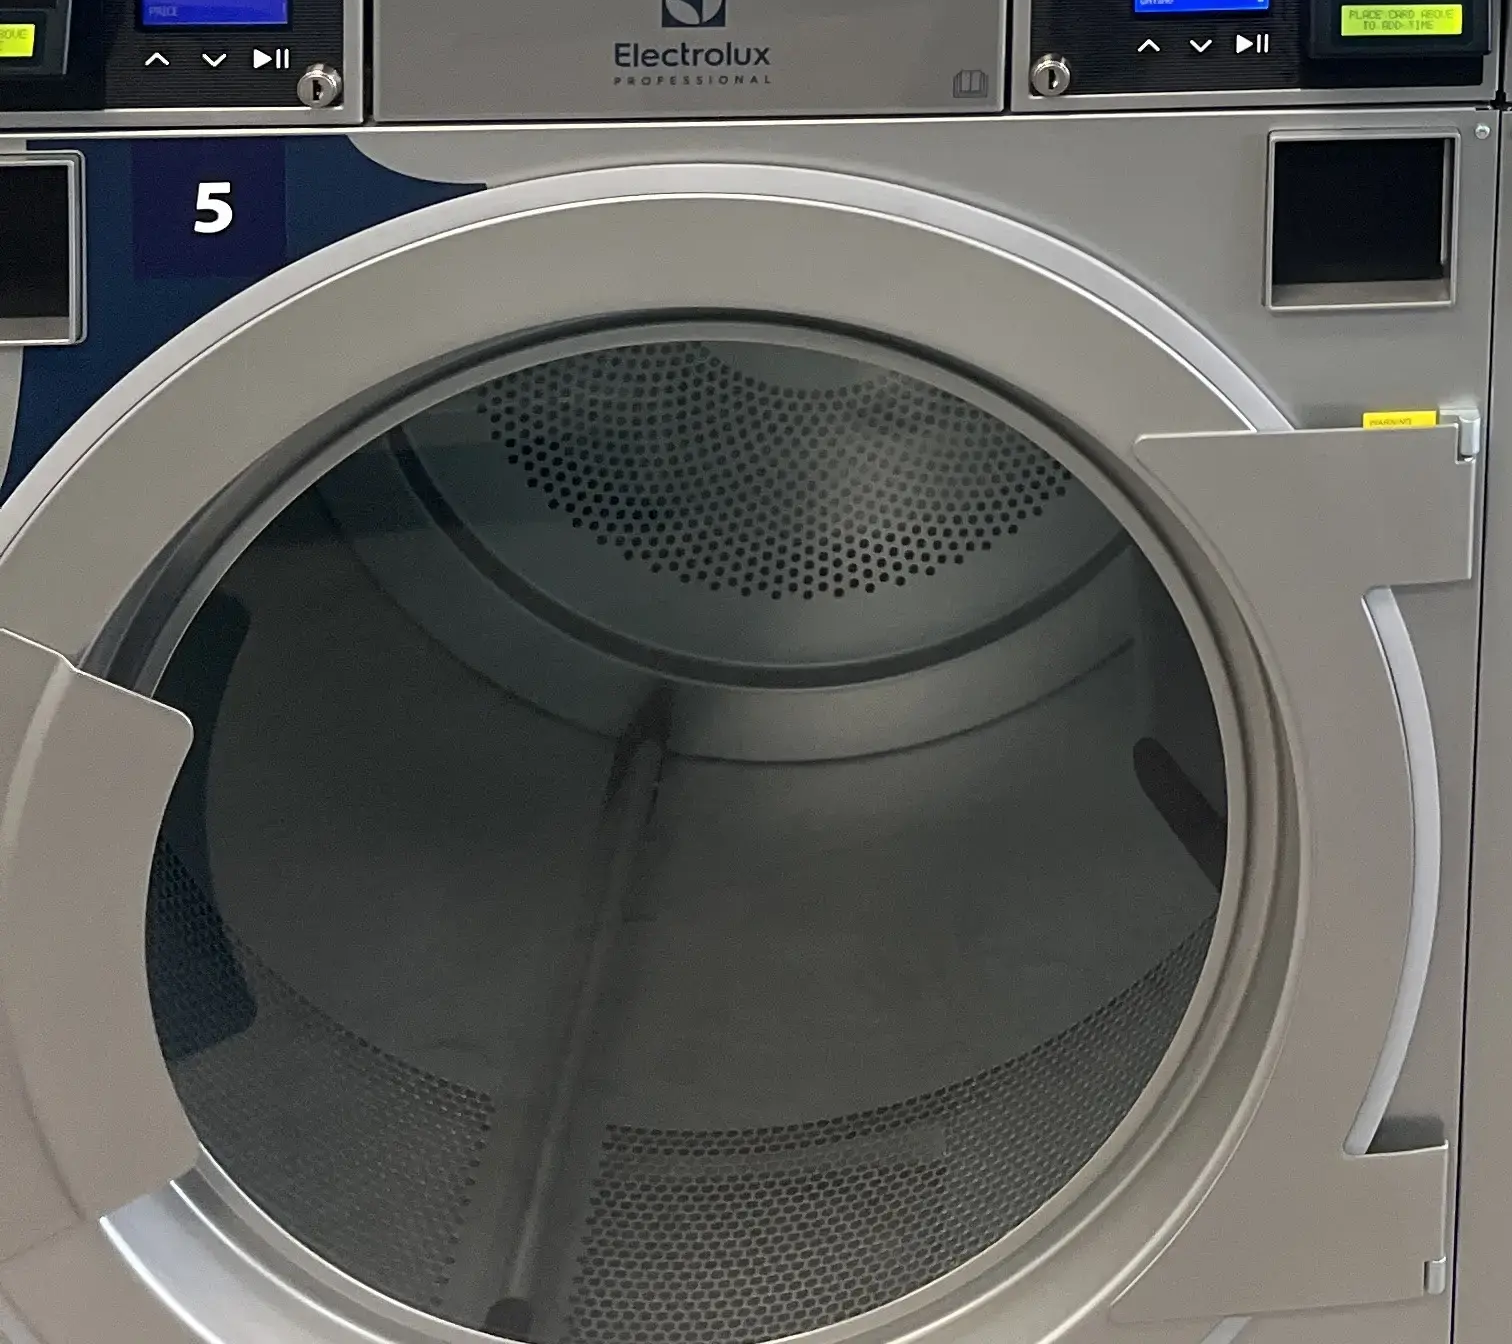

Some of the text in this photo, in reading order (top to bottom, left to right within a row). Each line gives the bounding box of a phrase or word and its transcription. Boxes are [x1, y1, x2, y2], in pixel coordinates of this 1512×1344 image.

[1349, 9, 1454, 19] PLACE CARD ABOVE
[1363, 21, 1376, 30] TO
[1409, 20, 1434, 30] TIME
[614, 42, 770, 67] Electrolux
[614, 75, 771, 85] PROFESSIONAL
[193, 181, 233, 234] 5
